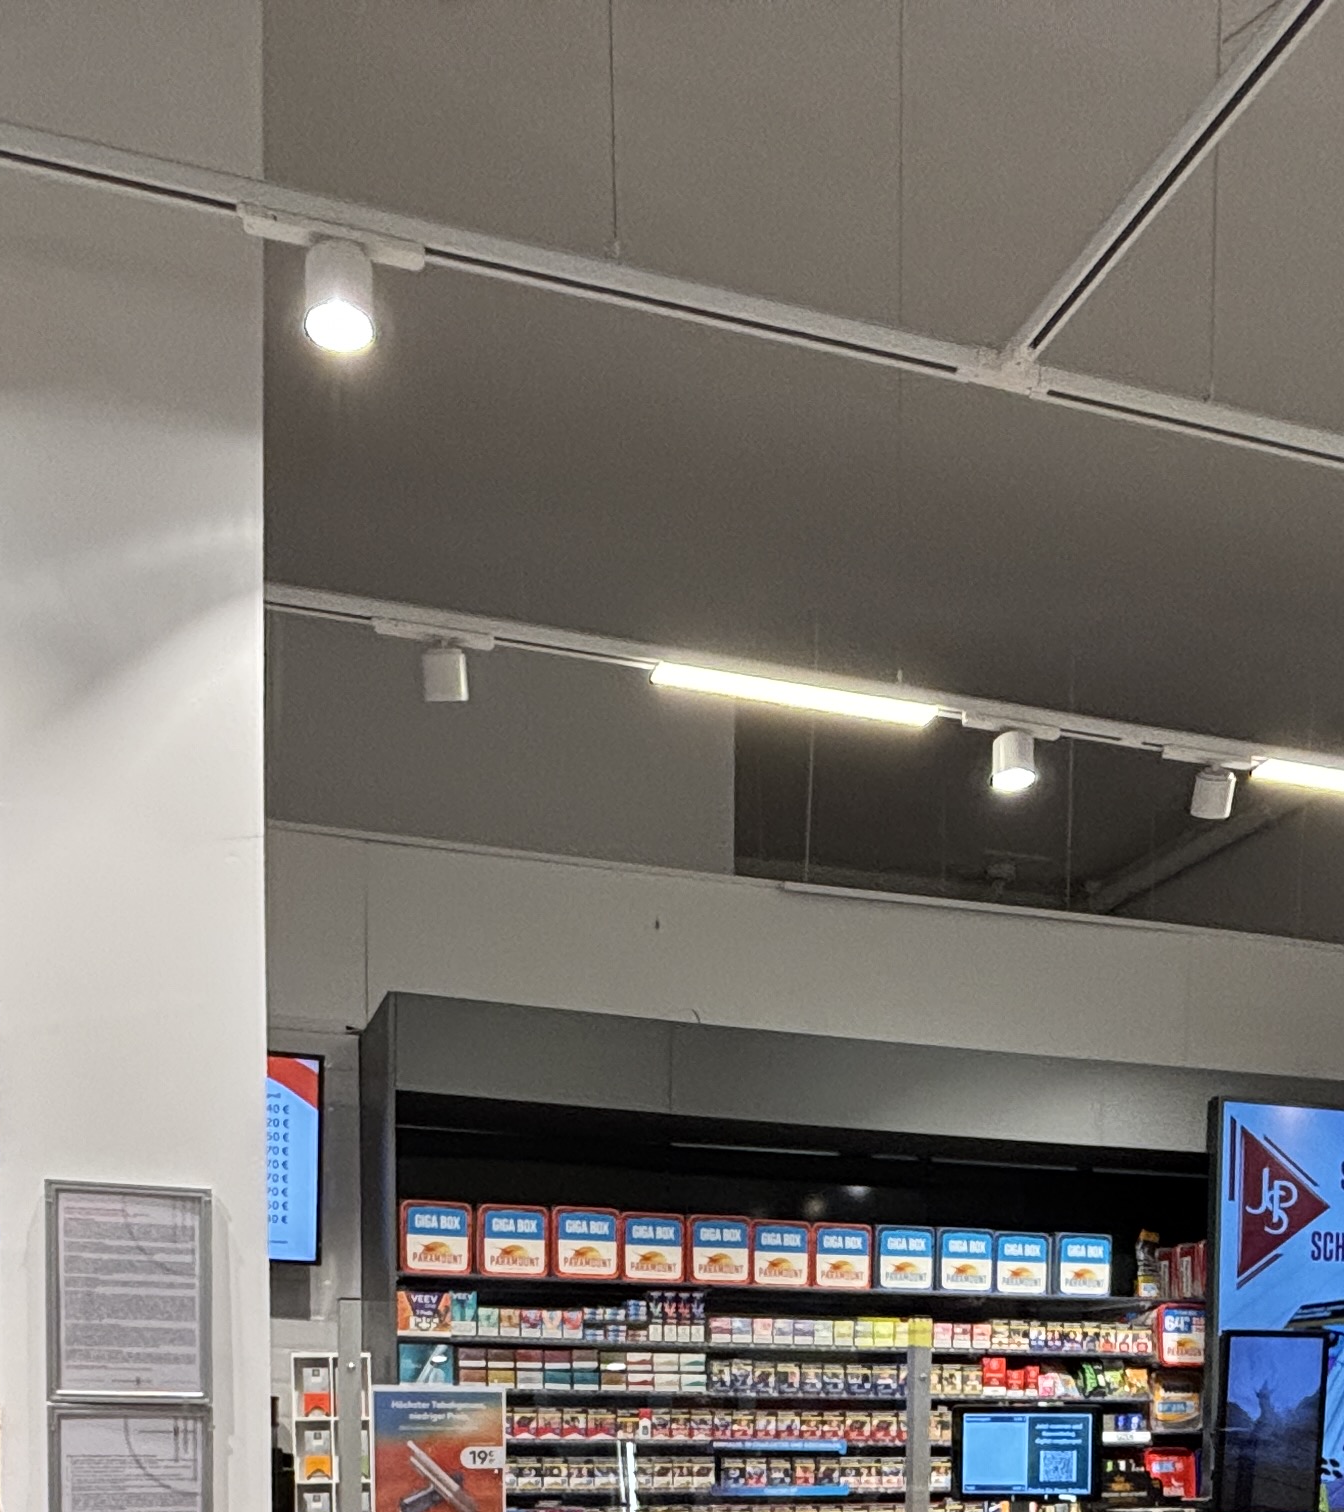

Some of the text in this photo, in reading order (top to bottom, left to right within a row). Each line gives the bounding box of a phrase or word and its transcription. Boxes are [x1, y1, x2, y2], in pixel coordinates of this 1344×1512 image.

[415, 1214, 460, 1230] GIGA BOX
[492, 1218, 537, 1233] GIGA BOX
[565, 1220, 609, 1235] GIGA BOX
[412, 1252, 463, 1265] PARAMOUNT
[490, 1256, 540, 1267] PARAMOUNT
[563, 1257, 612, 1268] PARAMOUNT
[411, 1295, 438, 1304] VEEV
